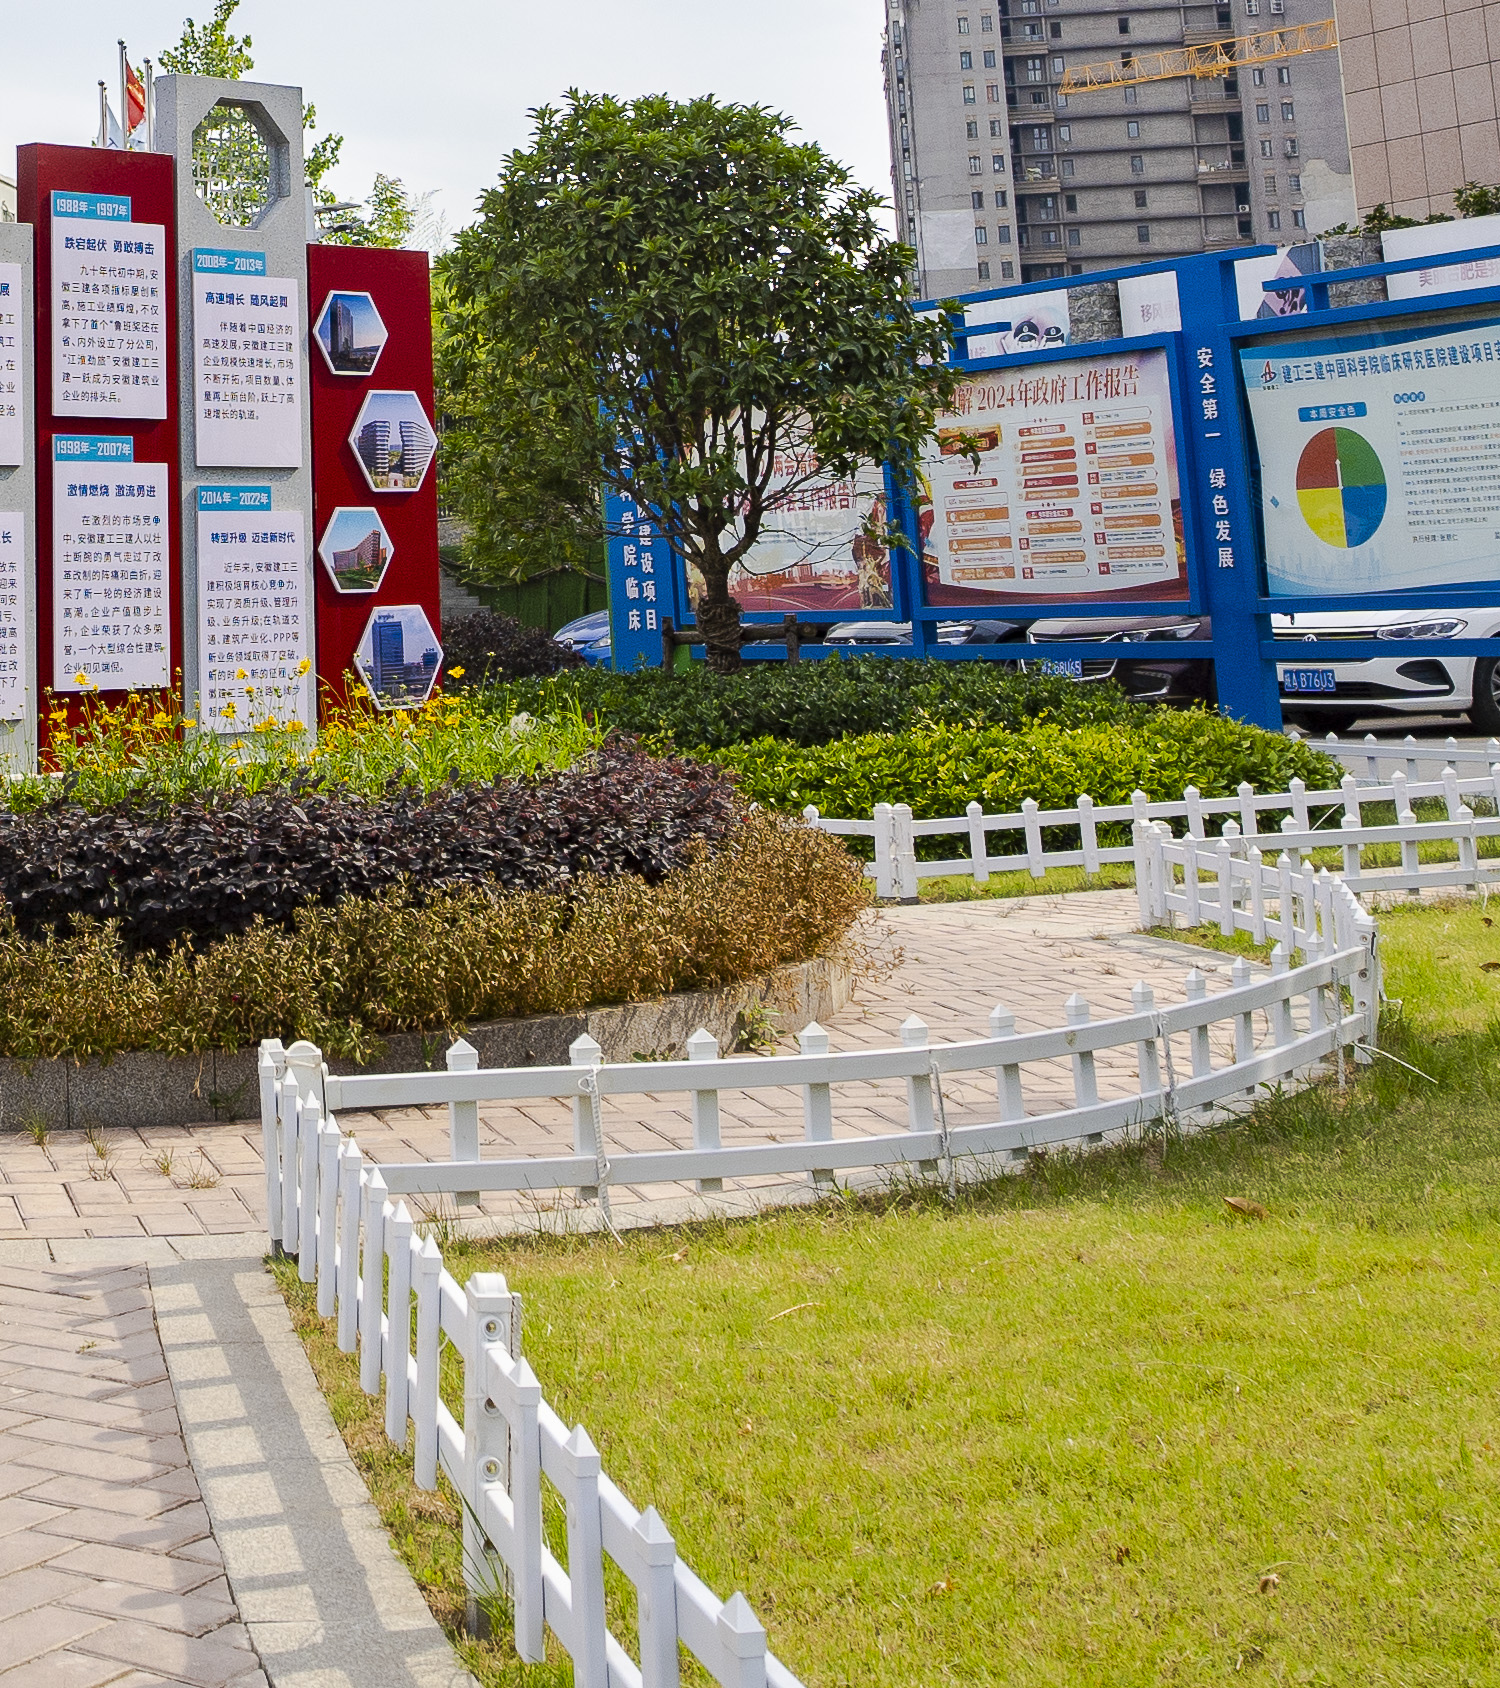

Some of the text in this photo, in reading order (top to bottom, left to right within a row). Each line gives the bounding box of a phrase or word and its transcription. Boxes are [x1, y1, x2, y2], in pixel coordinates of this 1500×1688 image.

[65, 237, 154, 255] 跌宕起伏 勇敢搏击
[205, 292, 288, 307] 高速增长 随风起舞
[220, 321, 292, 335] 伴随着中国经济的
[62, 372, 159, 386] 建一跃成为安徽建筑业
[977, 364, 1140, 411] 2024年政府工作报告
[1197, 347, 1234, 568] 安全第一 绿色发展
[67, 484, 156, 497] 激情燃烧 激流勇进
[82, 515, 160, 526] 在激烈的市场竞争
[211, 532, 295, 544] 转型升级 迈进新时代
[63, 587, 162, 599] 来了新一轮的经济建设
